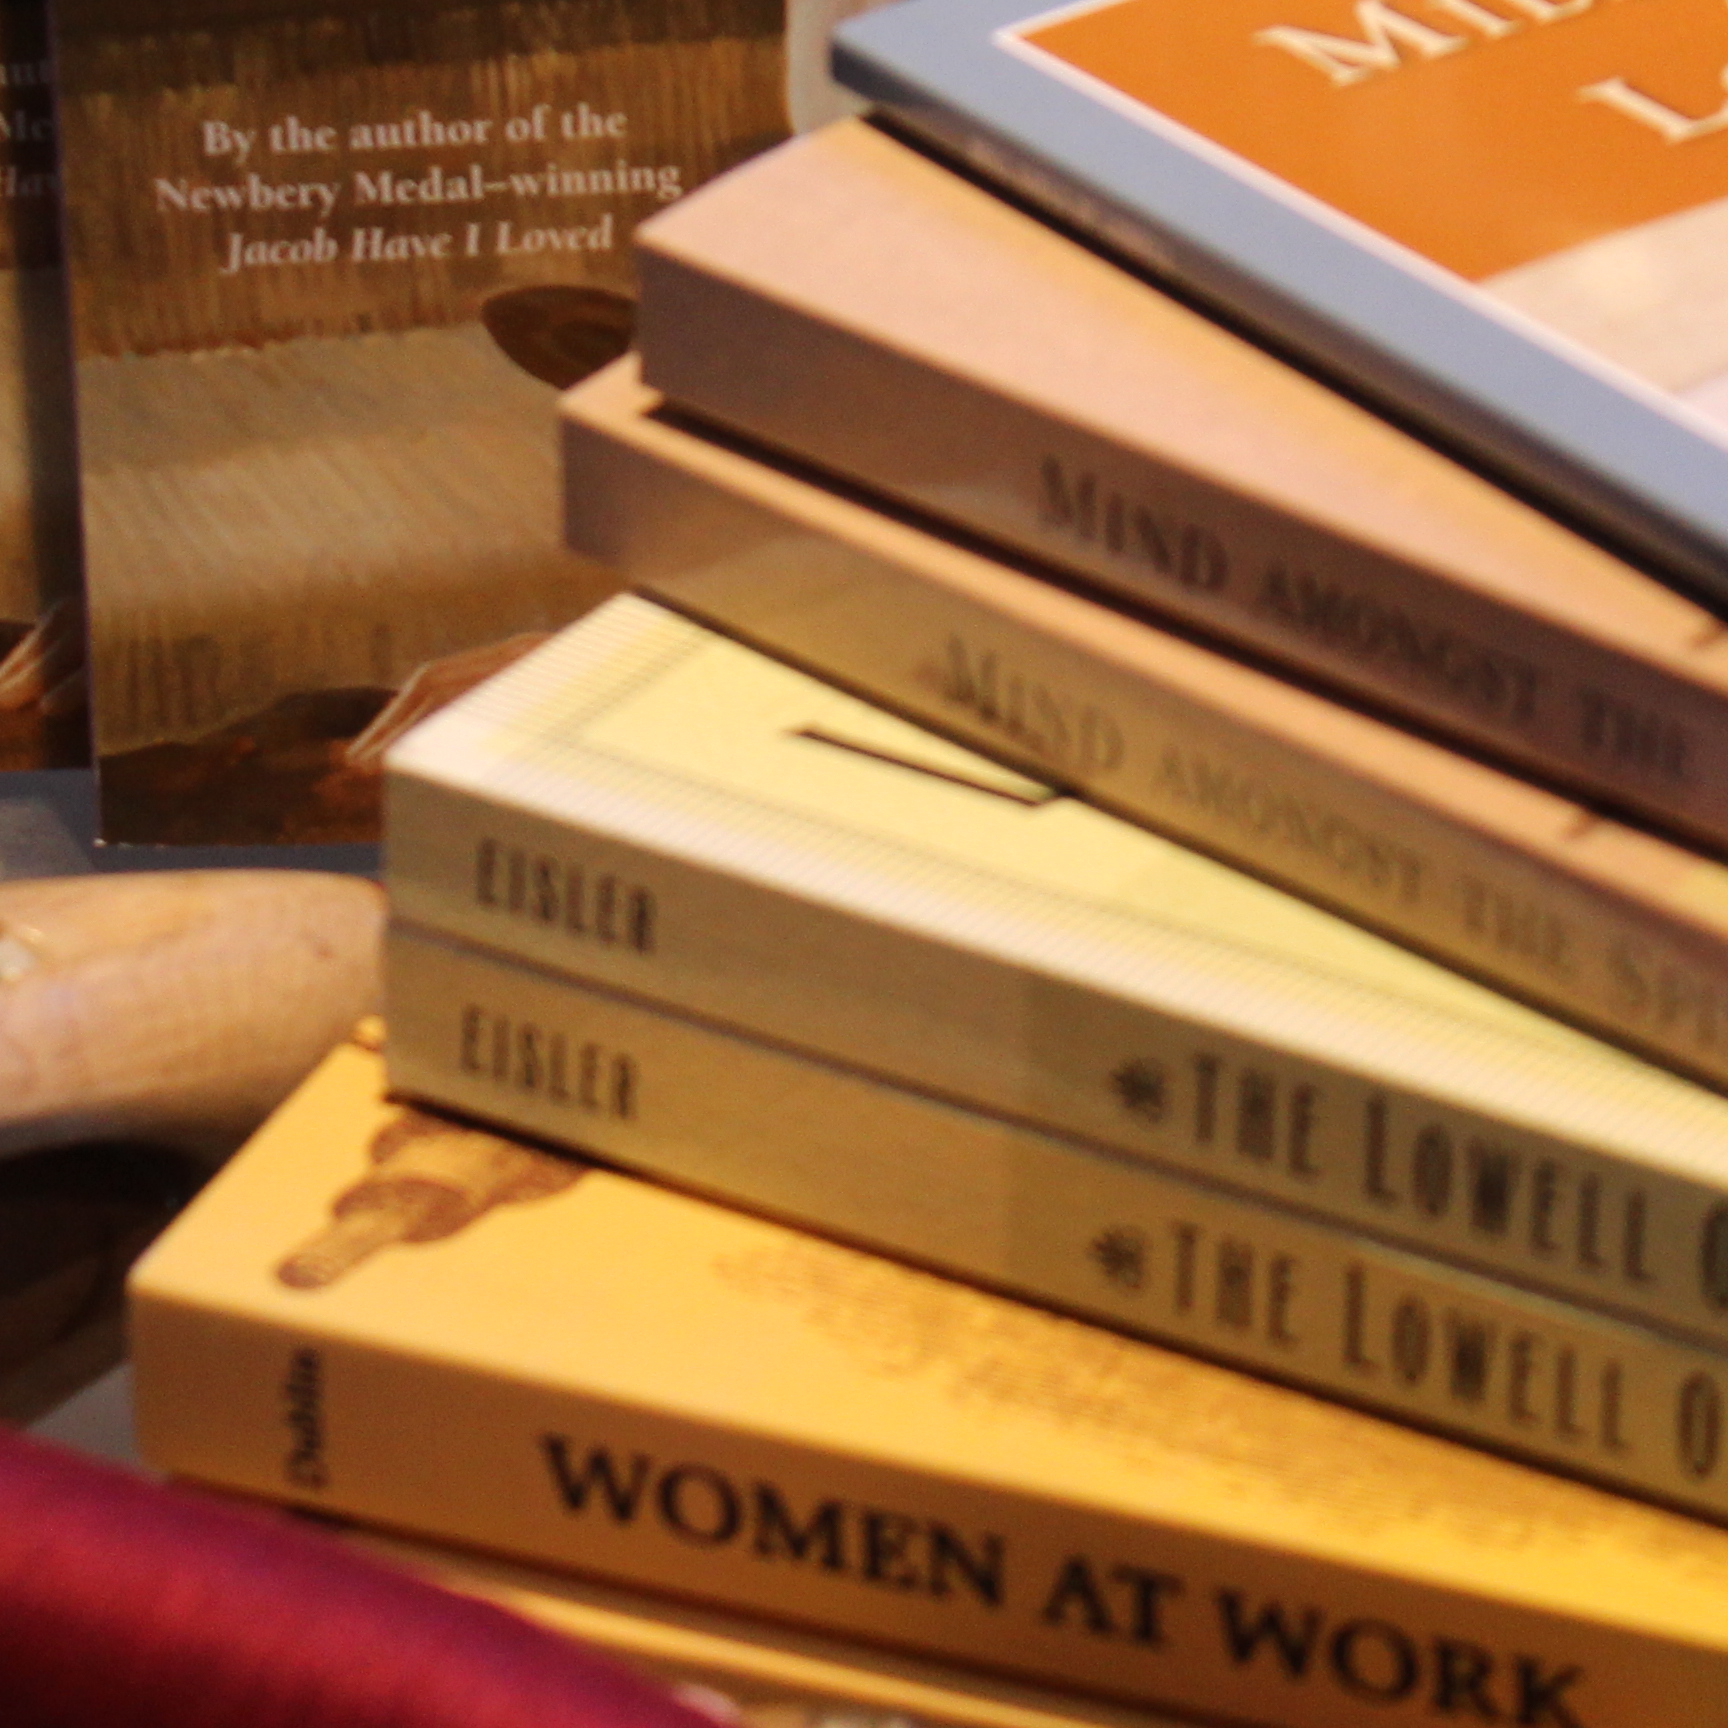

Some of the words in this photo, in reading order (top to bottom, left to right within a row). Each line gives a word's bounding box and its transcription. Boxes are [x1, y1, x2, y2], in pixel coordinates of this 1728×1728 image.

[154, 173, 337, 219] Newbery
[201, 119, 255, 164] By
[271, 116, 338, 156] the
[348, 110, 490, 152] author
[504, 104, 550, 144] of
[559, 102, 628, 142] the
[221, 229, 338, 274] Jacob
[351, 225, 453, 262] Have
[463, 223, 480, 256] I
[494, 212, 614, 256] Loved
[475, 835, 659, 955] EISLER
[1193, 1052, 1321, 1180] THE
[1364, 1090, 1657, 1284] LOWELL
[462, 1004, 640, 1121] EISLER
[1173, 1220, 1300, 1350] THE
[1343, 1260, 1632, 1457] LOWELL
[542, 1431, 1006, 1610] WOMEN
[1044, 1553, 1182, 1652] AT
[1214, 1587, 1588, 1728] WORK
